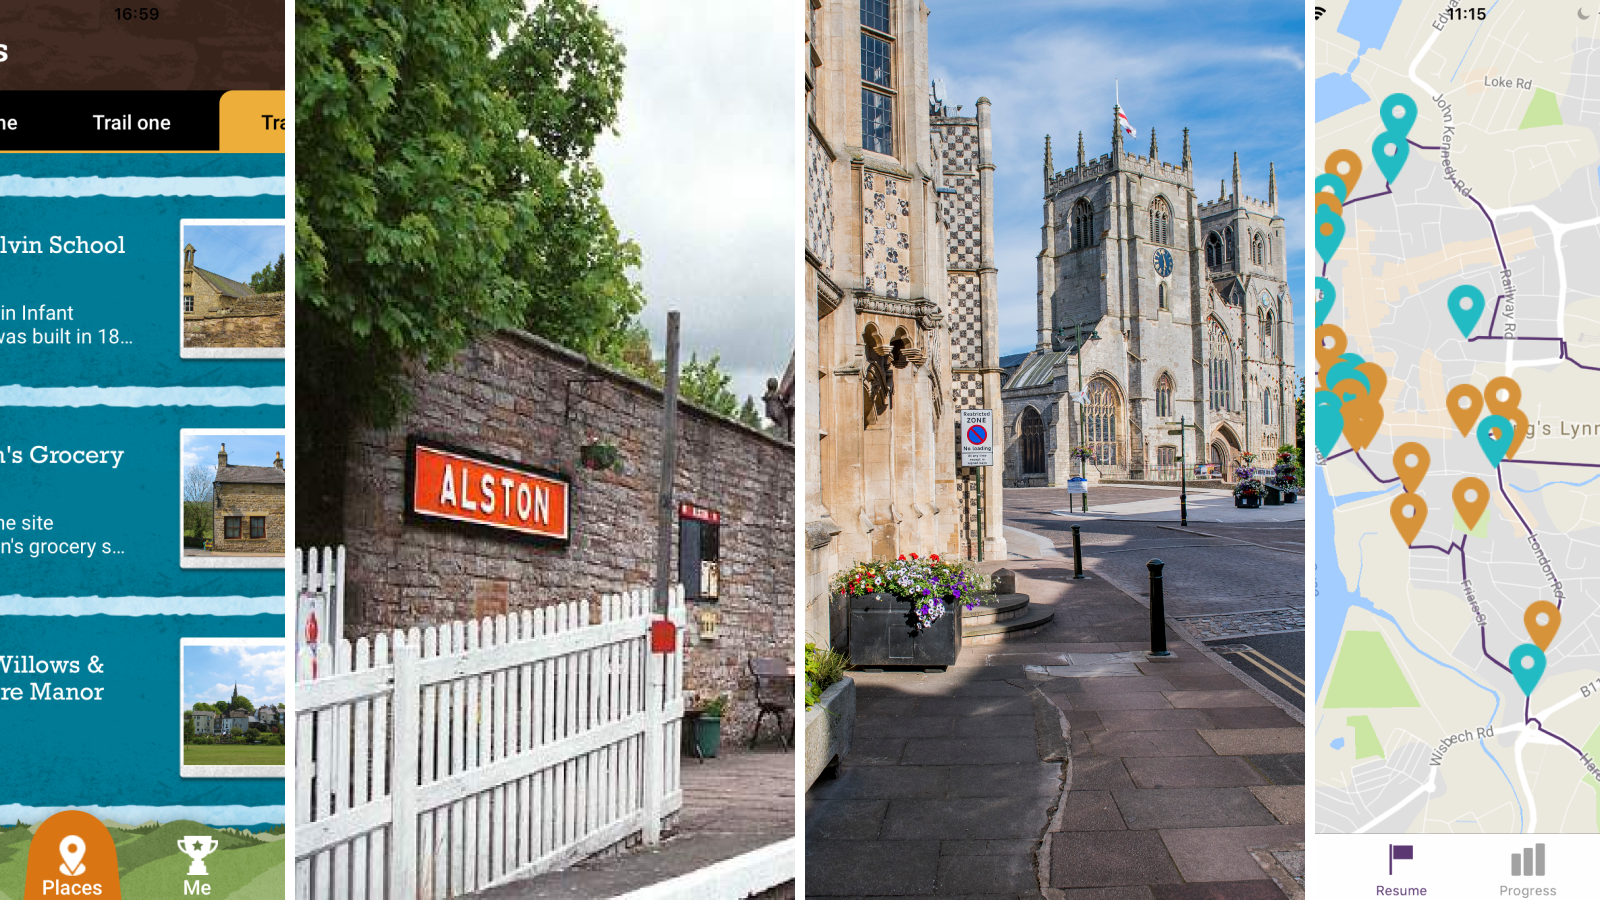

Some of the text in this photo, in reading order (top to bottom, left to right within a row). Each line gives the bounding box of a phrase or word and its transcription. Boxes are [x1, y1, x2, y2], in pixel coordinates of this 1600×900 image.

[114, 7, 159, 20] 16:59
[1447, 7, 1487, 21] 11:15
[1484, 75, 1533, 90] Loke Rd
[92, 113, 171, 131] Trail one
[1432, 93, 1473, 198] John Kennedy Rd
[0, 235, 126, 254] lvin School
[1, 304, 74, 321] in Infant
[1500, 269, 1517, 340] Railway Rd
[33, 327, 71, 344] built
[77, 328, 92, 344] in
[98, 328, 133, 344] 18...
[29, 445, 125, 469] Grocery
[440, 463, 549, 526] ALSTON
[21, 514, 54, 531] site
[1, 537, 125, 558] n's grocery s...
[1527, 533, 1567, 599] London Rd
[1461, 579, 1488, 627] Friars St
[87, 655, 104, 673] &
[0, 682, 105, 701] re Manor
[1429, 724, 1495, 766] Wisbech Rd
[42, 879, 103, 896] Places
[183, 879, 212, 896] Me
[1376, 885, 1428, 896] Resume
[1499, 885, 1557, 899] Progress
